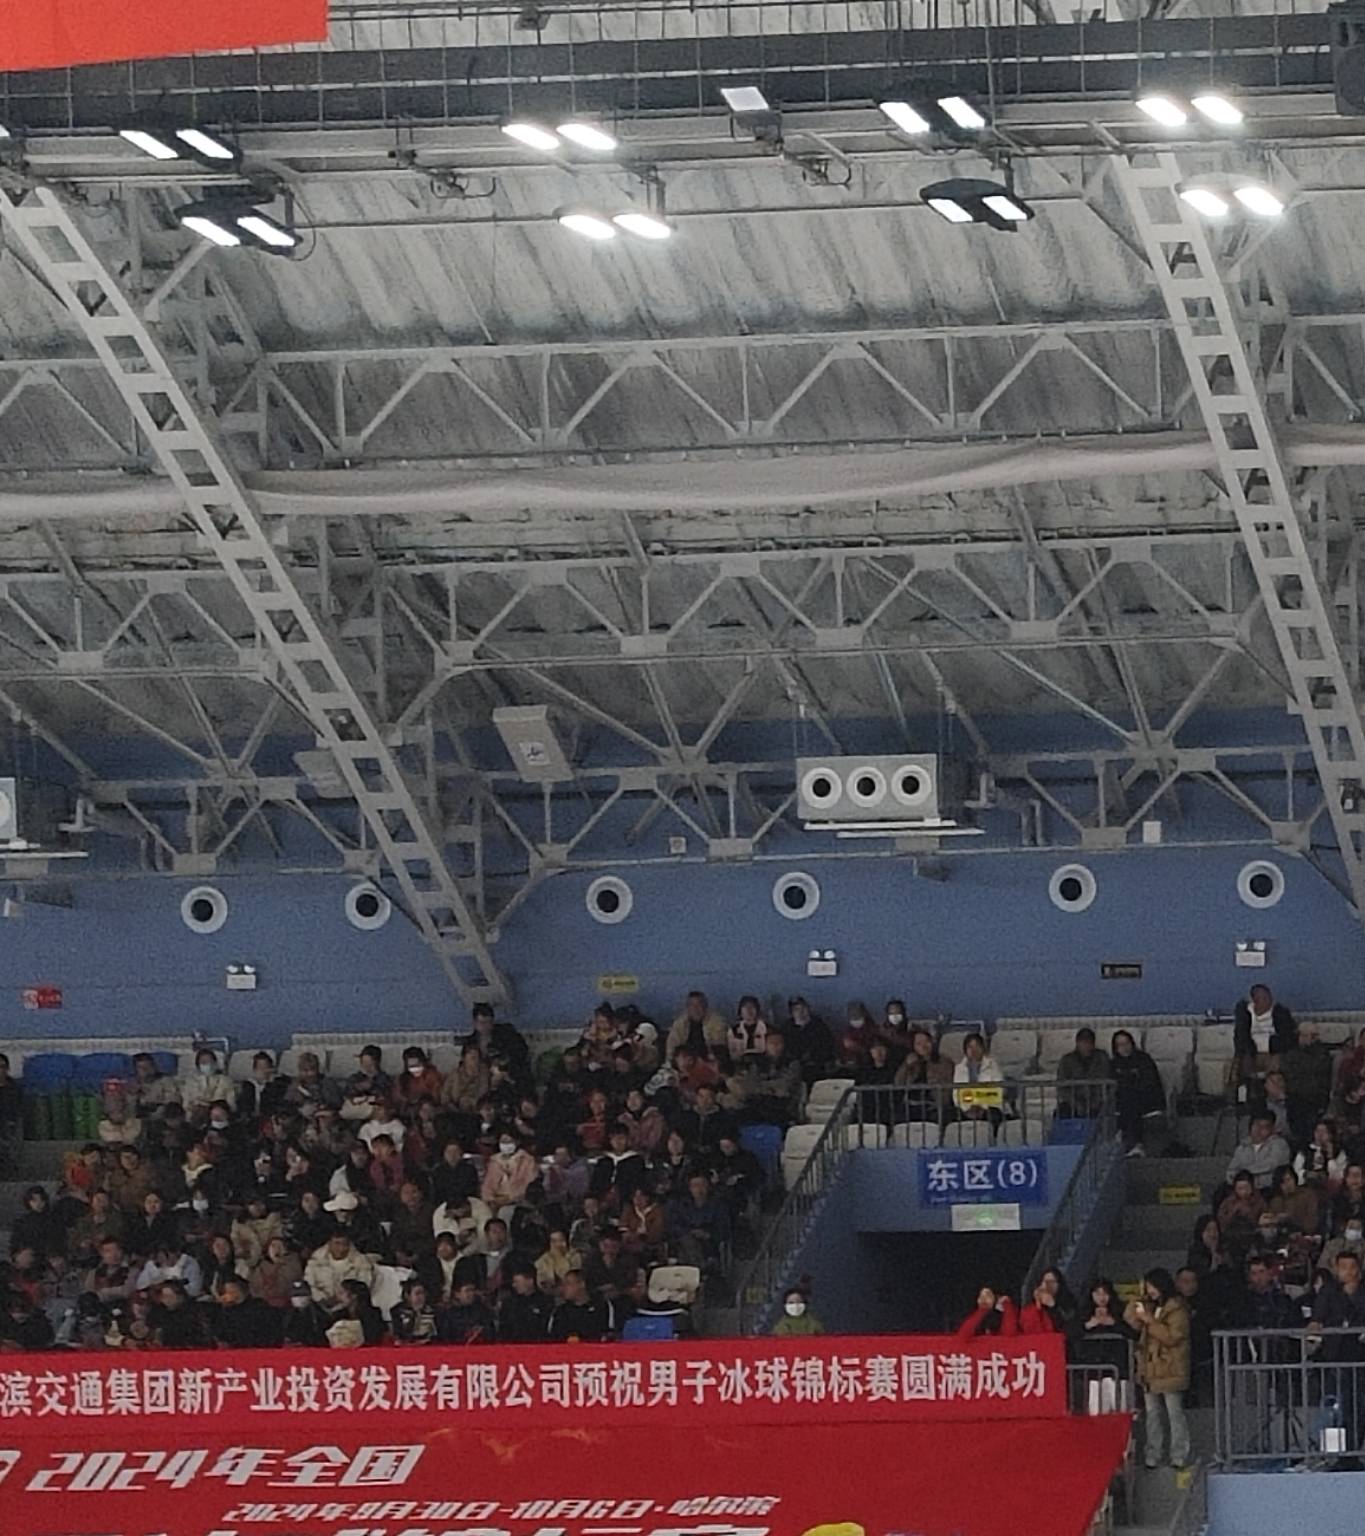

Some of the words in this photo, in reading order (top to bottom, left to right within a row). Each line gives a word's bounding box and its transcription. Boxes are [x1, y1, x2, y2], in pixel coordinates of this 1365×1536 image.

[927, 1159, 1038, 1191] 东区(8)
[25, 1444, 426, 1491] 2024年全国
